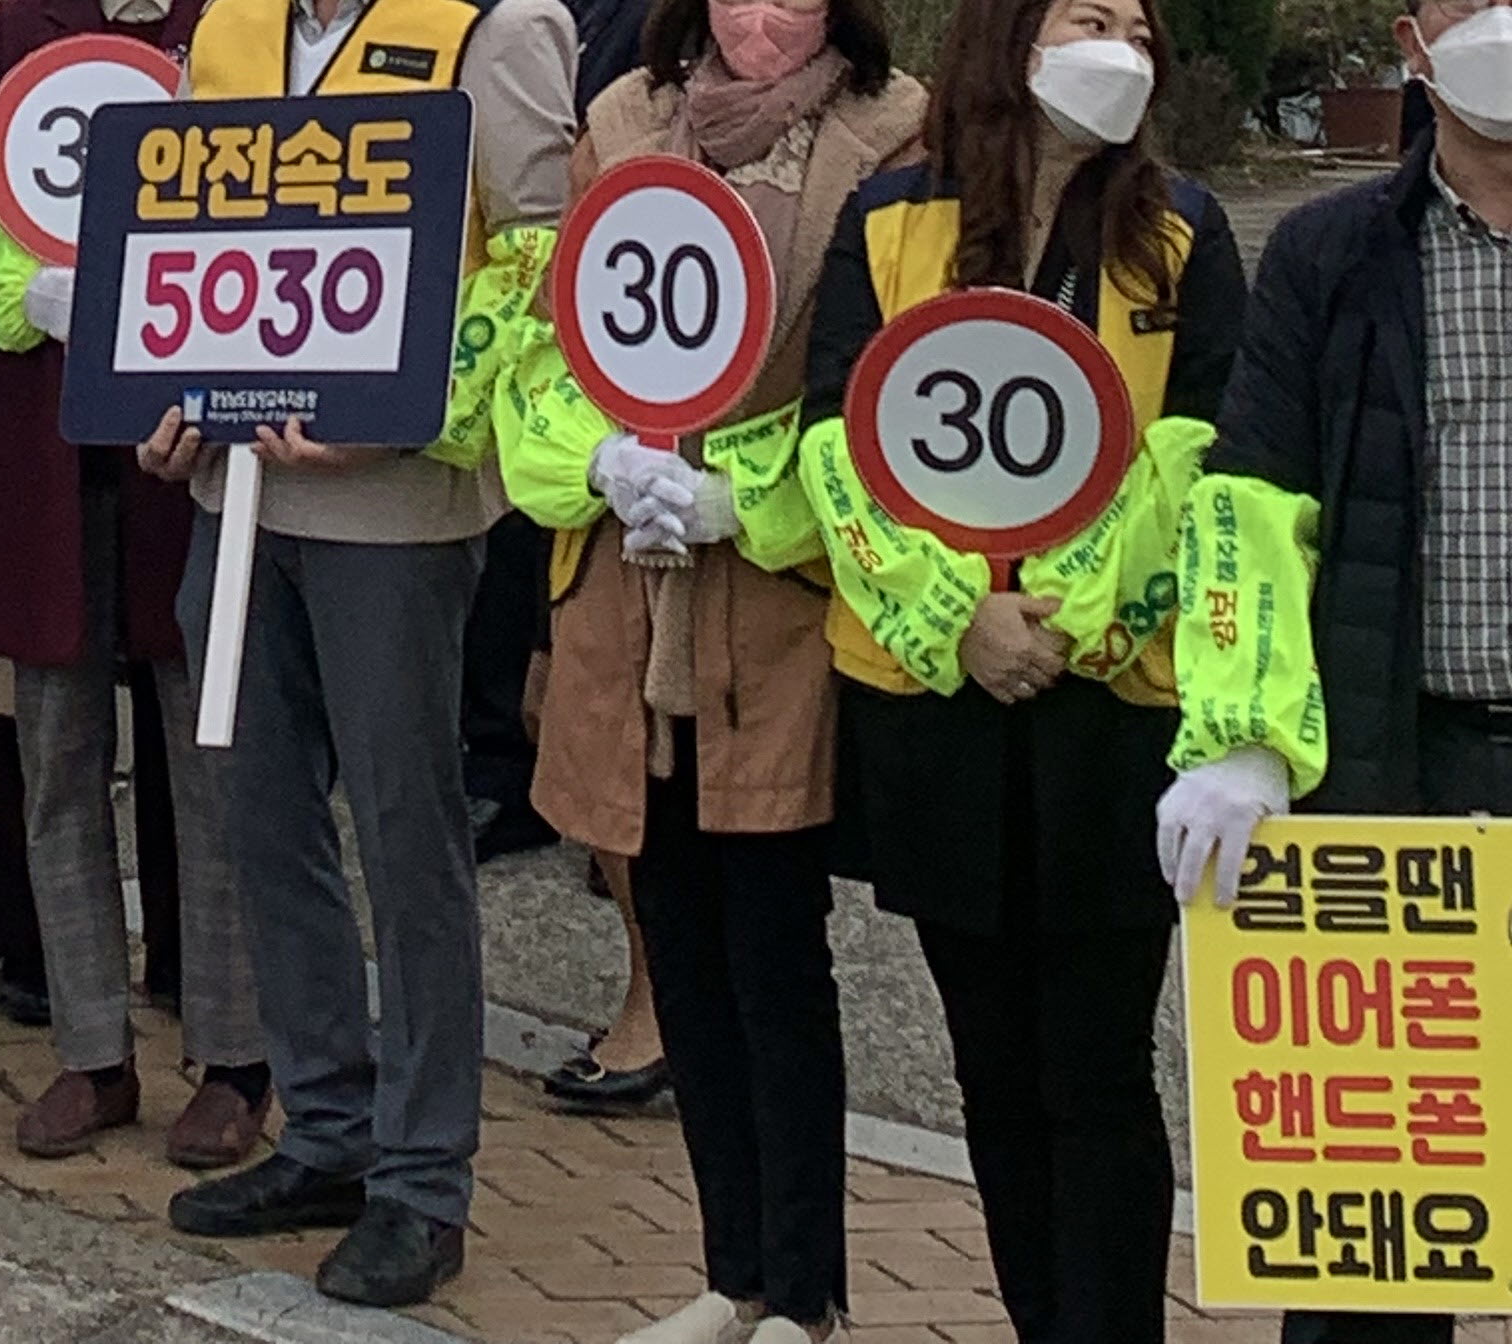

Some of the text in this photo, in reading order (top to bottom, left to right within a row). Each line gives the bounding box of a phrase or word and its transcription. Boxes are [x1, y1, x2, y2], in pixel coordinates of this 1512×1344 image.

[136, 118, 414, 221] 안전속도
[139, 245, 385, 359] 5030
[601, 237, 721, 352] 30
[909, 368, 1067, 479] 30
[1232, 842, 1480, 937] 걸을땐
[1231, 956, 1483, 1052] 이어폰
[1233, 1070, 1490, 1170] 핸드폰
[1240, 1187, 1496, 1285] 안돼요
